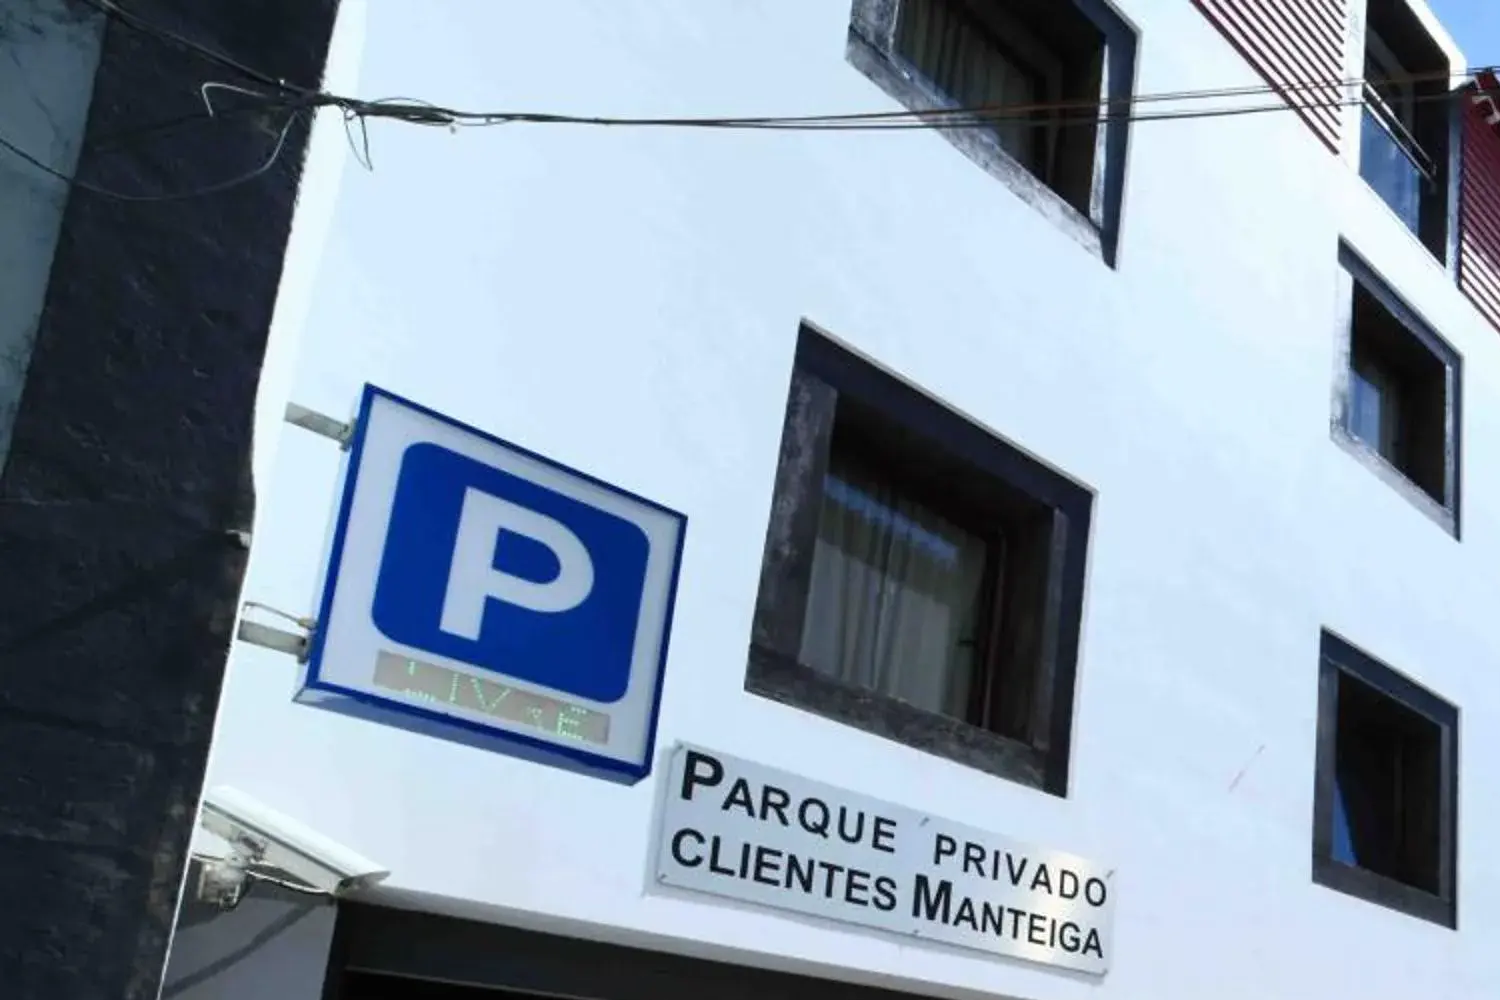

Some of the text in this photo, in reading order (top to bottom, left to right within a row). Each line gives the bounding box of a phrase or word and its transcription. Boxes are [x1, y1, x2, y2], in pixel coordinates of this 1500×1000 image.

[439, 486, 595, 642] P
[671, 827, 1104, 960] CLIENTES MANTEIGA
[680, 749, 1108, 908] PARQUE PRIVADO
